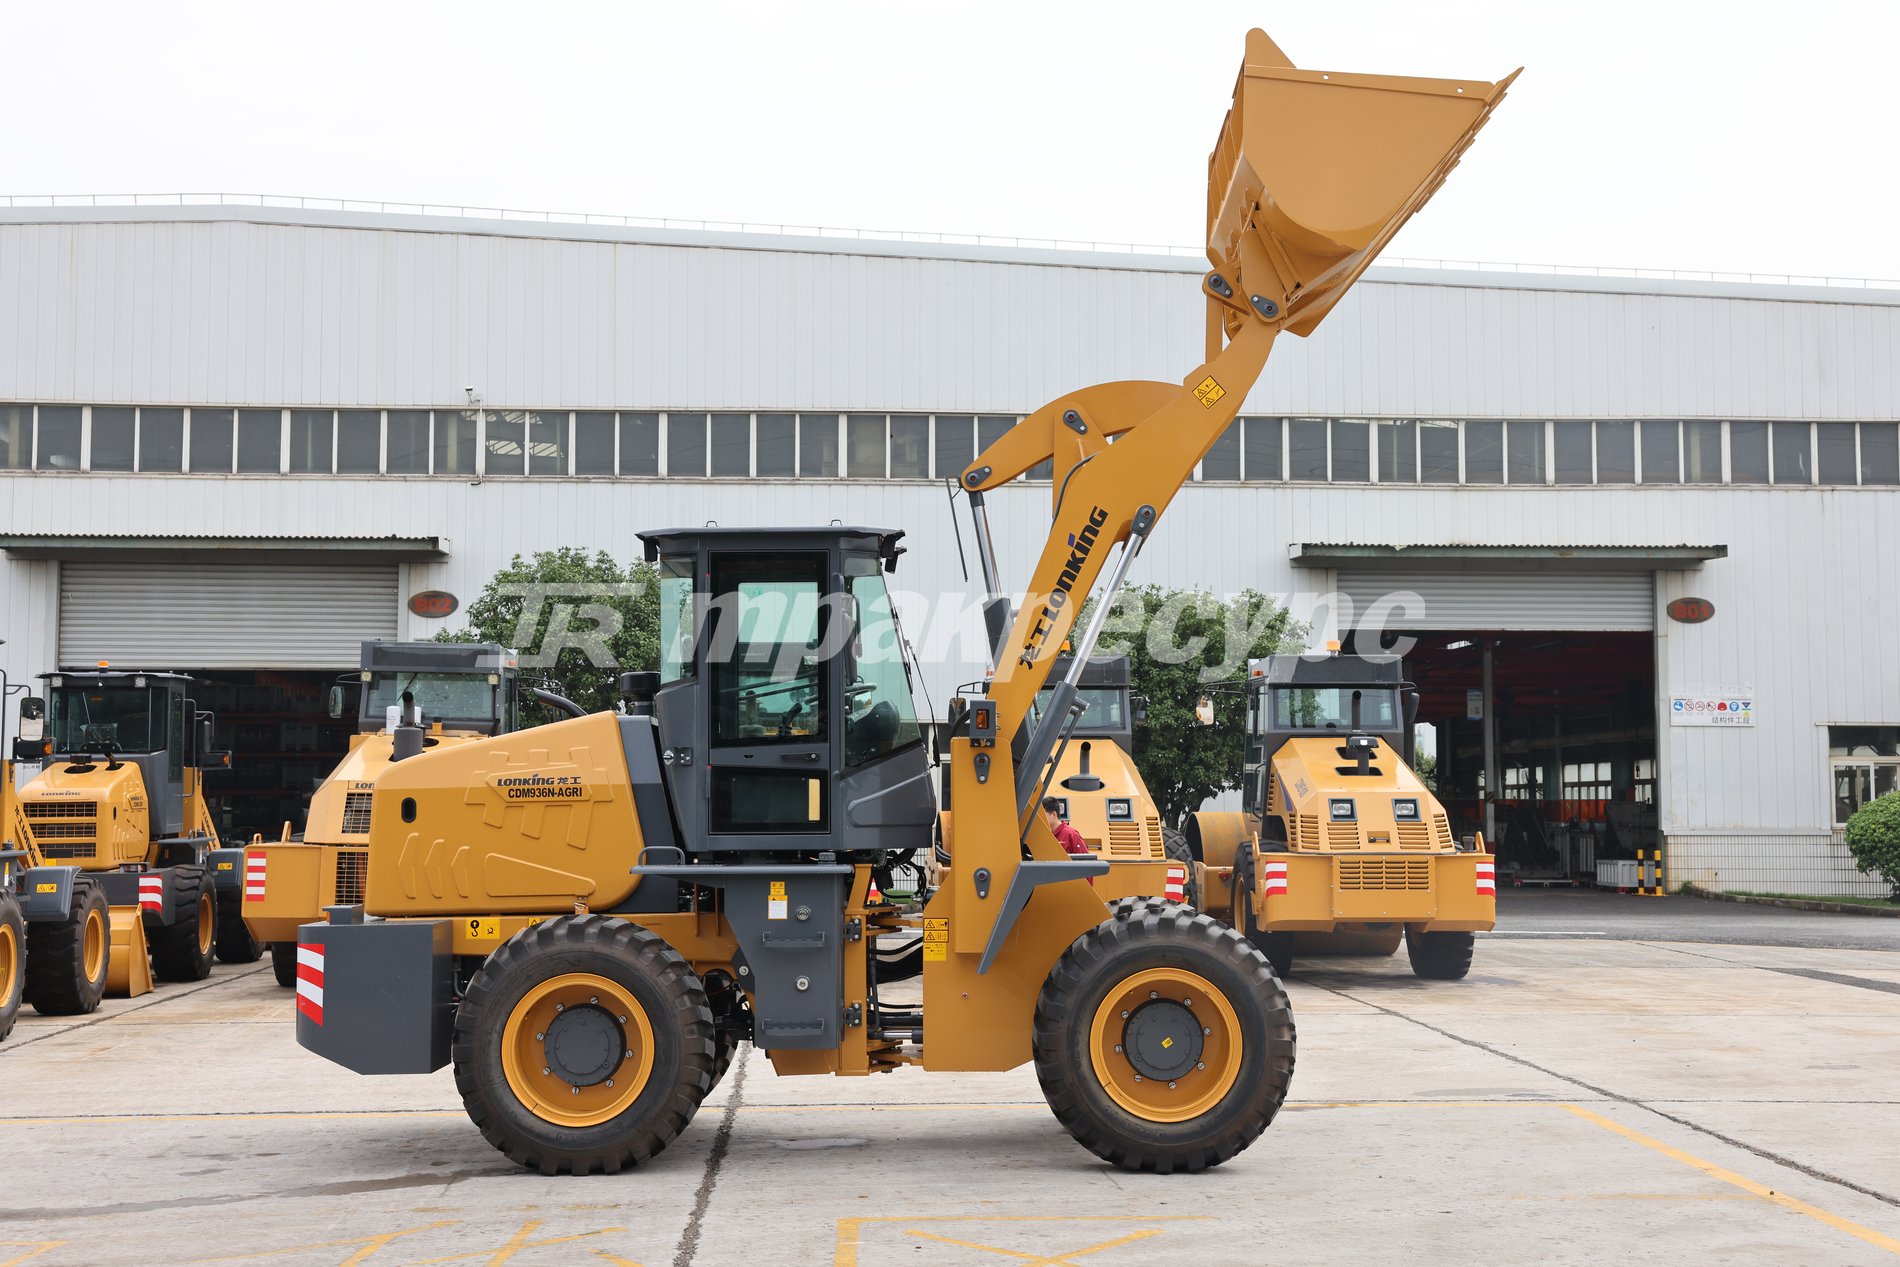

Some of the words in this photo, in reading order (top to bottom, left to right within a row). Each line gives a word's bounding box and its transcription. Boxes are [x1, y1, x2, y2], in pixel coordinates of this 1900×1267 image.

[415, 597, 453, 612] B02
[497, 773, 555, 787] LONKING
[557, 776, 582, 785] 龙工
[508, 786, 582, 799] CDM936N-AGRI
